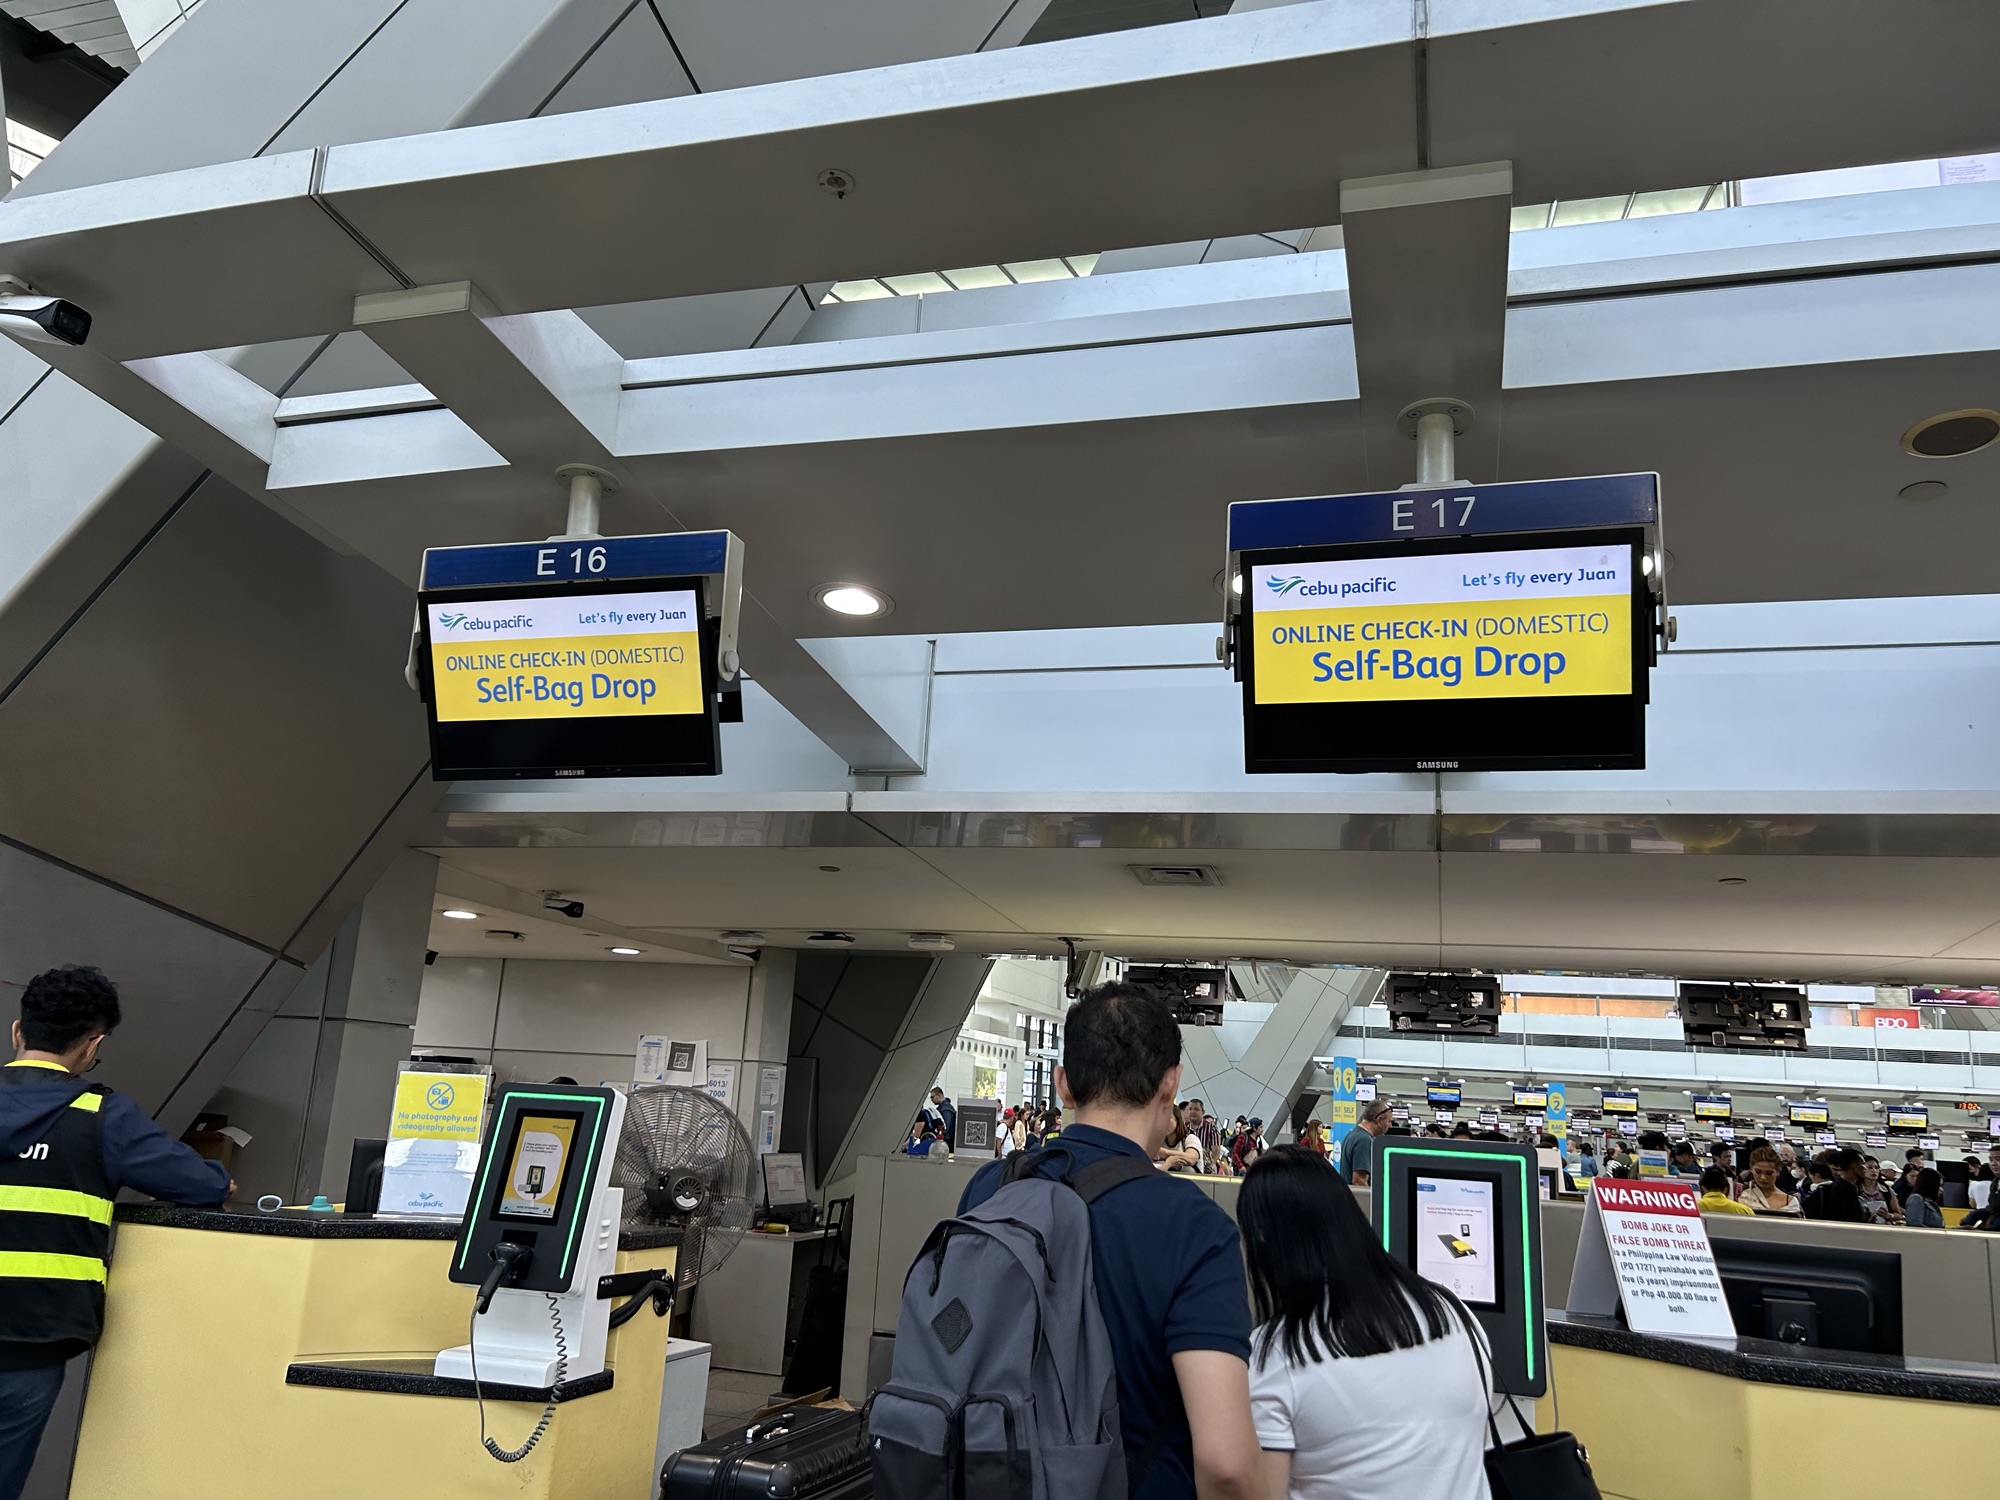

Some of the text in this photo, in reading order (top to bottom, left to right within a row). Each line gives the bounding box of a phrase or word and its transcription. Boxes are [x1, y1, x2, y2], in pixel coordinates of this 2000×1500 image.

[1392, 496, 1476, 531] E 17
[536, 546, 607, 576] E 16
[1505, 571, 1526, 588] fly
[1530, 572, 1573, 585] every
[1578, 568, 1616, 582] Juan
[1299, 577, 1397, 598] cebu pacific
[463, 615, 533, 632] cebu pacific
[609, 611, 623, 625] fly
[626, 612, 656, 623] every
[660, 609, 687, 620] Juan
[1272, 612, 1609, 645] ONLINE CHECK-IN (DOMESTIC)
[446, 646, 684, 671] ONLINE CHECK-IN (DOMESTIC)
[1312, 645, 1566, 687] Self-Bag Drop
[476, 673, 657, 707] Self-Bag Drop
[1874, 1017, 1909, 1029] BDO
[1553, 1101, 1560, 1111] 2
[398, 1111, 409, 1119] No
[411, 1112, 461, 1123] photography
[397, 1122, 476, 1133] videography allowed
[423, 1200, 443, 1208] pacific
[1598, 1186, 1696, 1210] WARNING
[1621, 1220, 1690, 1234] BOMB JOKE OR
[1612, 1235, 1707, 1251] FALSE BOMB THREAT
[1628, 1249, 1664, 1260] Philippine
[1665, 1252, 1680, 1261] Law
[1681, 1254, 1713, 1263] Violation
[1620, 1262, 1714, 1276] (PD 1727) punishable with
[1622, 1274, 1720, 1290] five (5 years) imprisonment
[1640, 1289, 1655, 1299] Php
[1694, 1294, 1708, 1302] fine
[1668, 1304, 1688, 1314] both.
